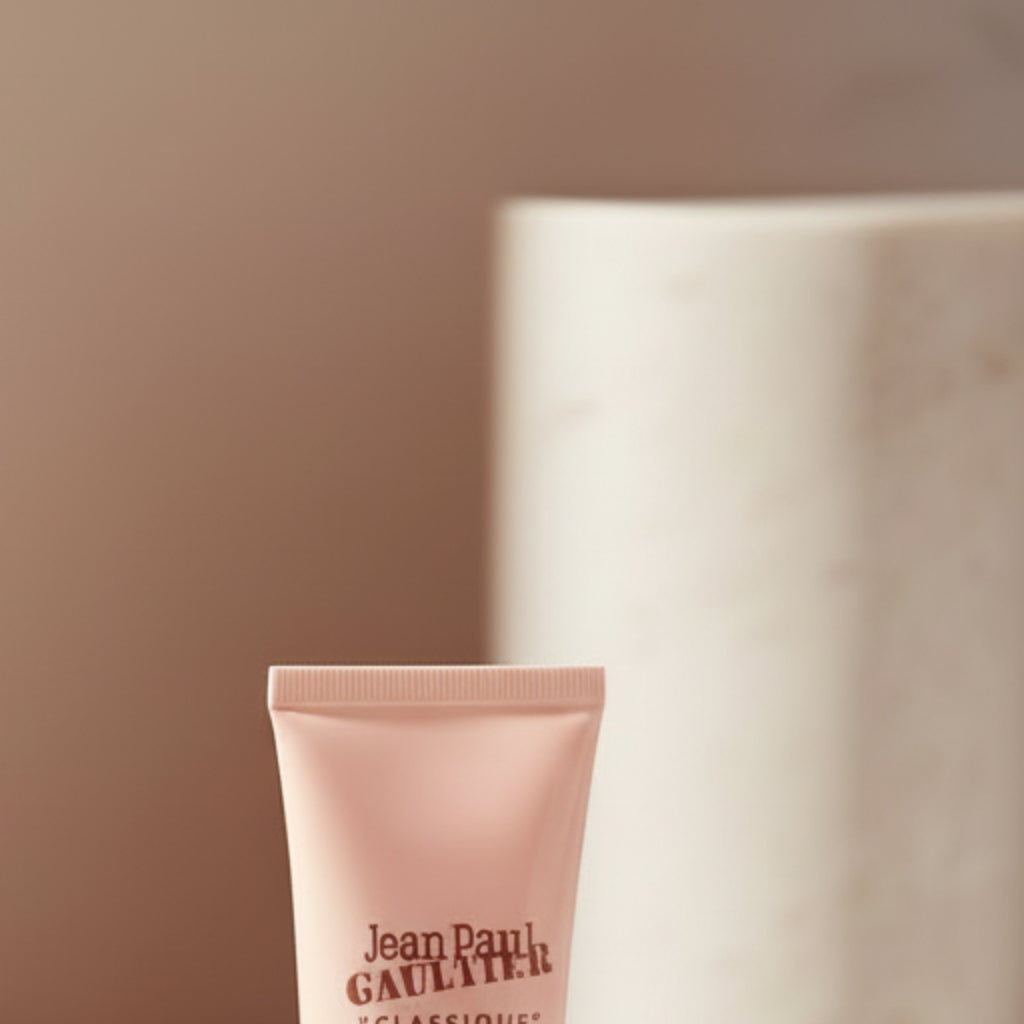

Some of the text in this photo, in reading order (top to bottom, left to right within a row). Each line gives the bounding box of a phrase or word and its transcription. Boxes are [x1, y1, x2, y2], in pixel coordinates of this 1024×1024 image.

[364, 922, 533, 963] Jean Paul
[346, 942, 553, 1006] GAULTIER
